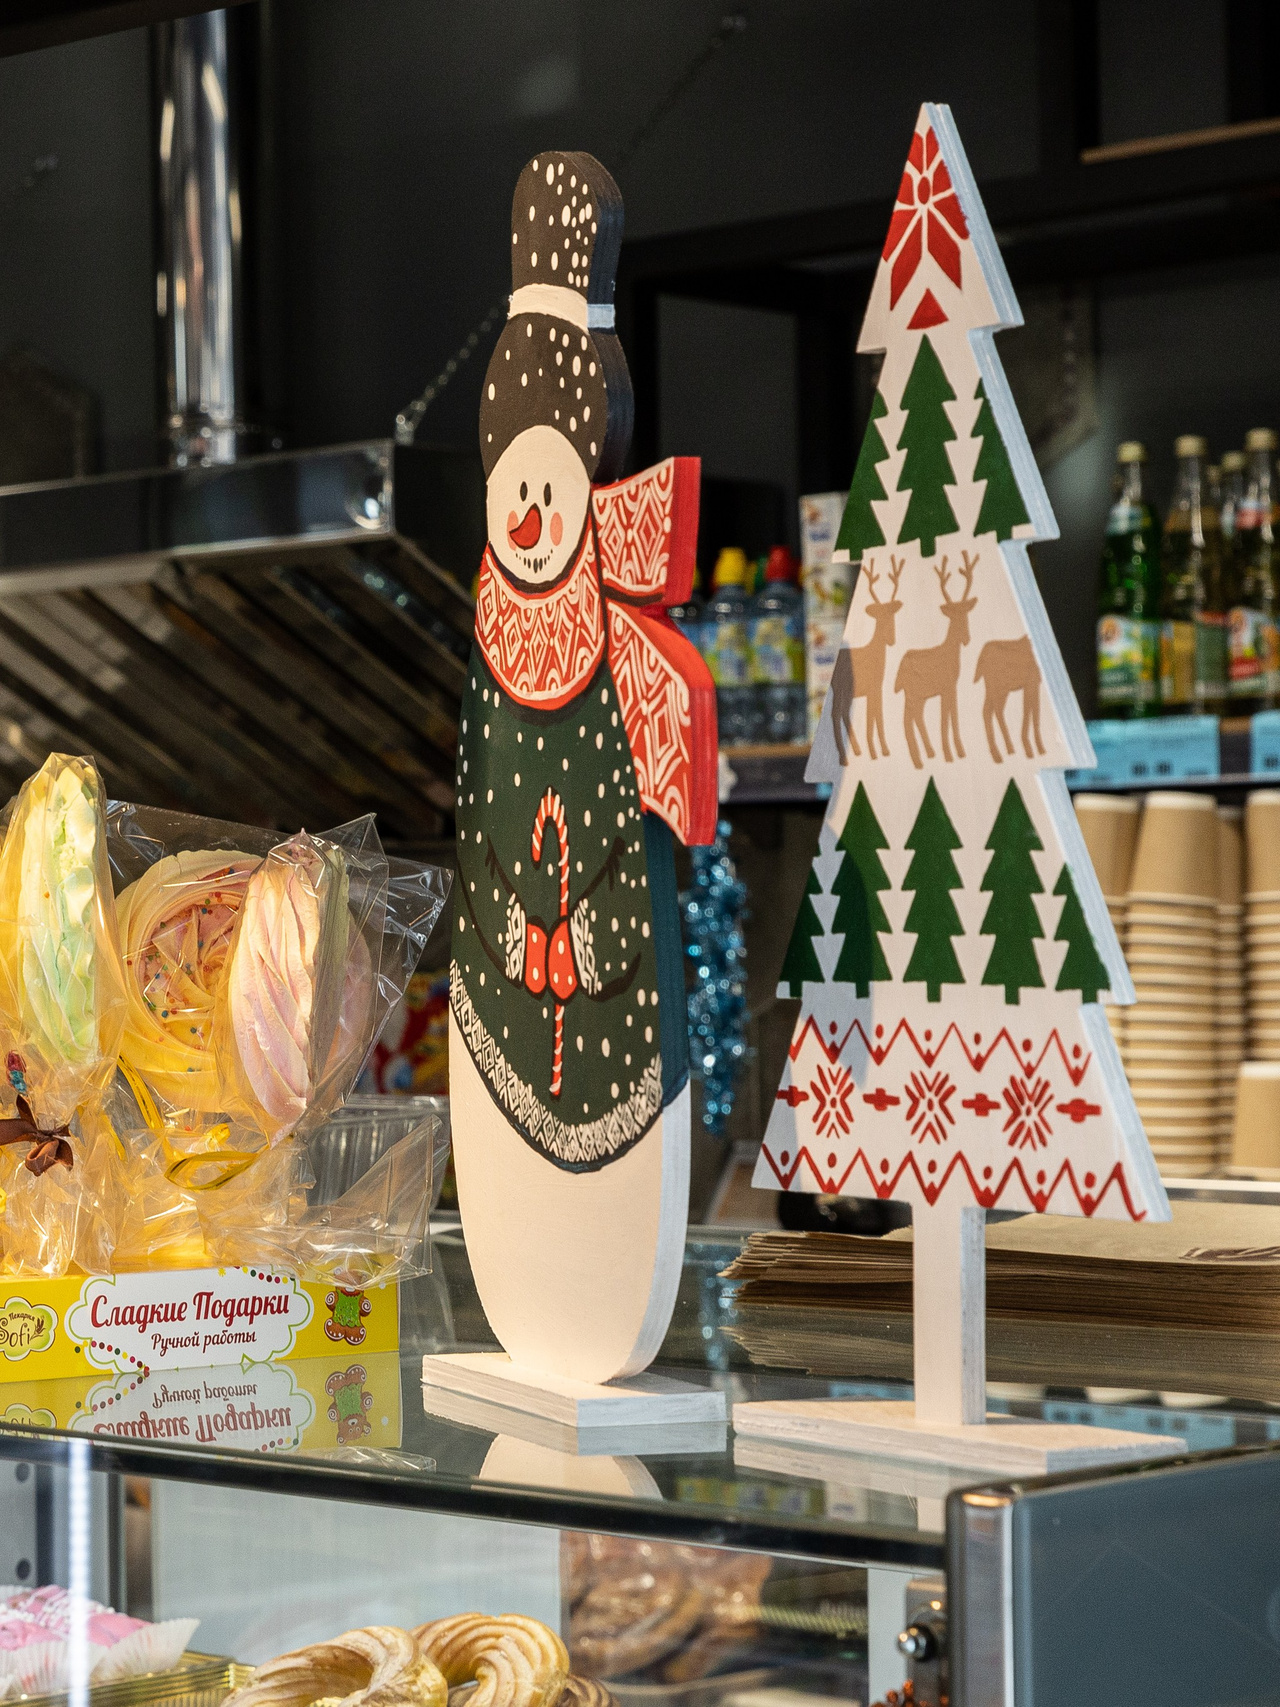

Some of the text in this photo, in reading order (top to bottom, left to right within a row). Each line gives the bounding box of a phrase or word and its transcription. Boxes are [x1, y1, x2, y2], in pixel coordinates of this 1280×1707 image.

[8, 1311, 36, 1322] Пекарня
[91, 1291, 290, 1333] Сладкие Подарки
[151, 1330, 257, 1357] Ручной работы
